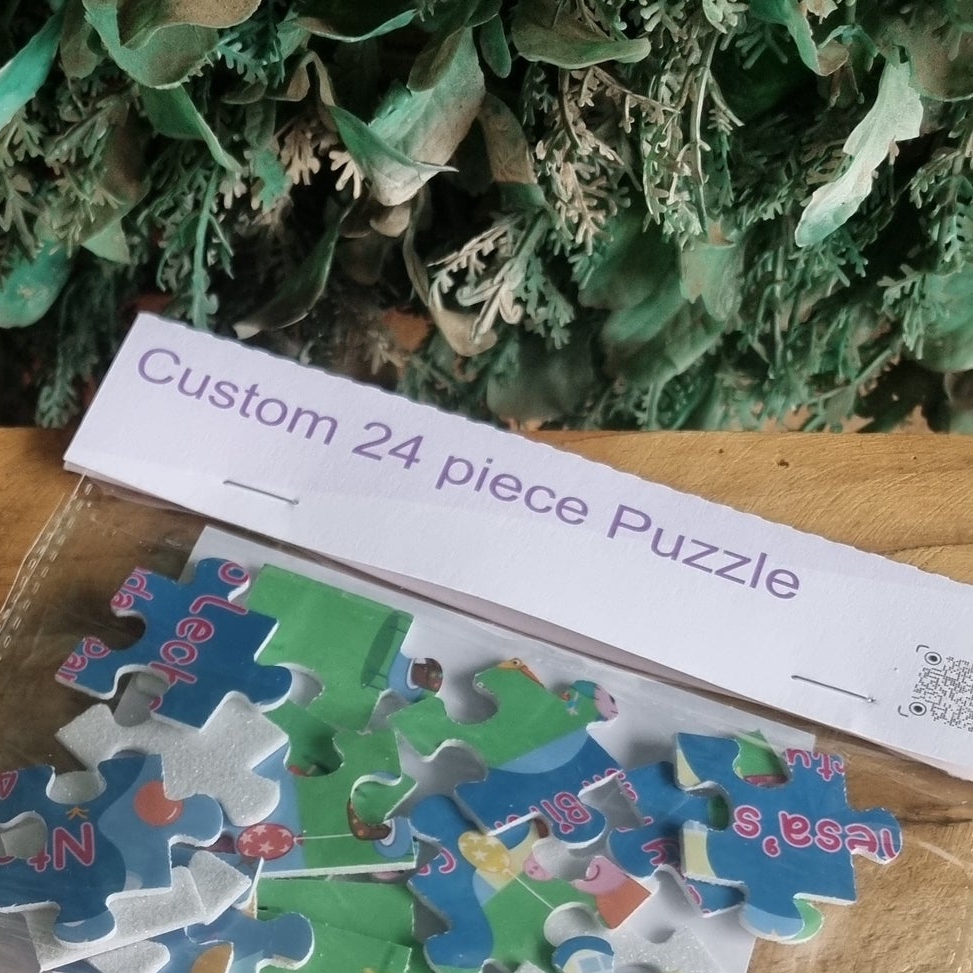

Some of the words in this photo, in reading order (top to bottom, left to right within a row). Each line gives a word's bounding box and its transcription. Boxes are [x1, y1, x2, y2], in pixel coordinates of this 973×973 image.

[137, 348, 339, 445] Custom
[351, 422, 424, 470] 24
[434, 455, 589, 526] piece
[605, 503, 801, 600] Puzzle
[148, 594, 249, 711] Lech
